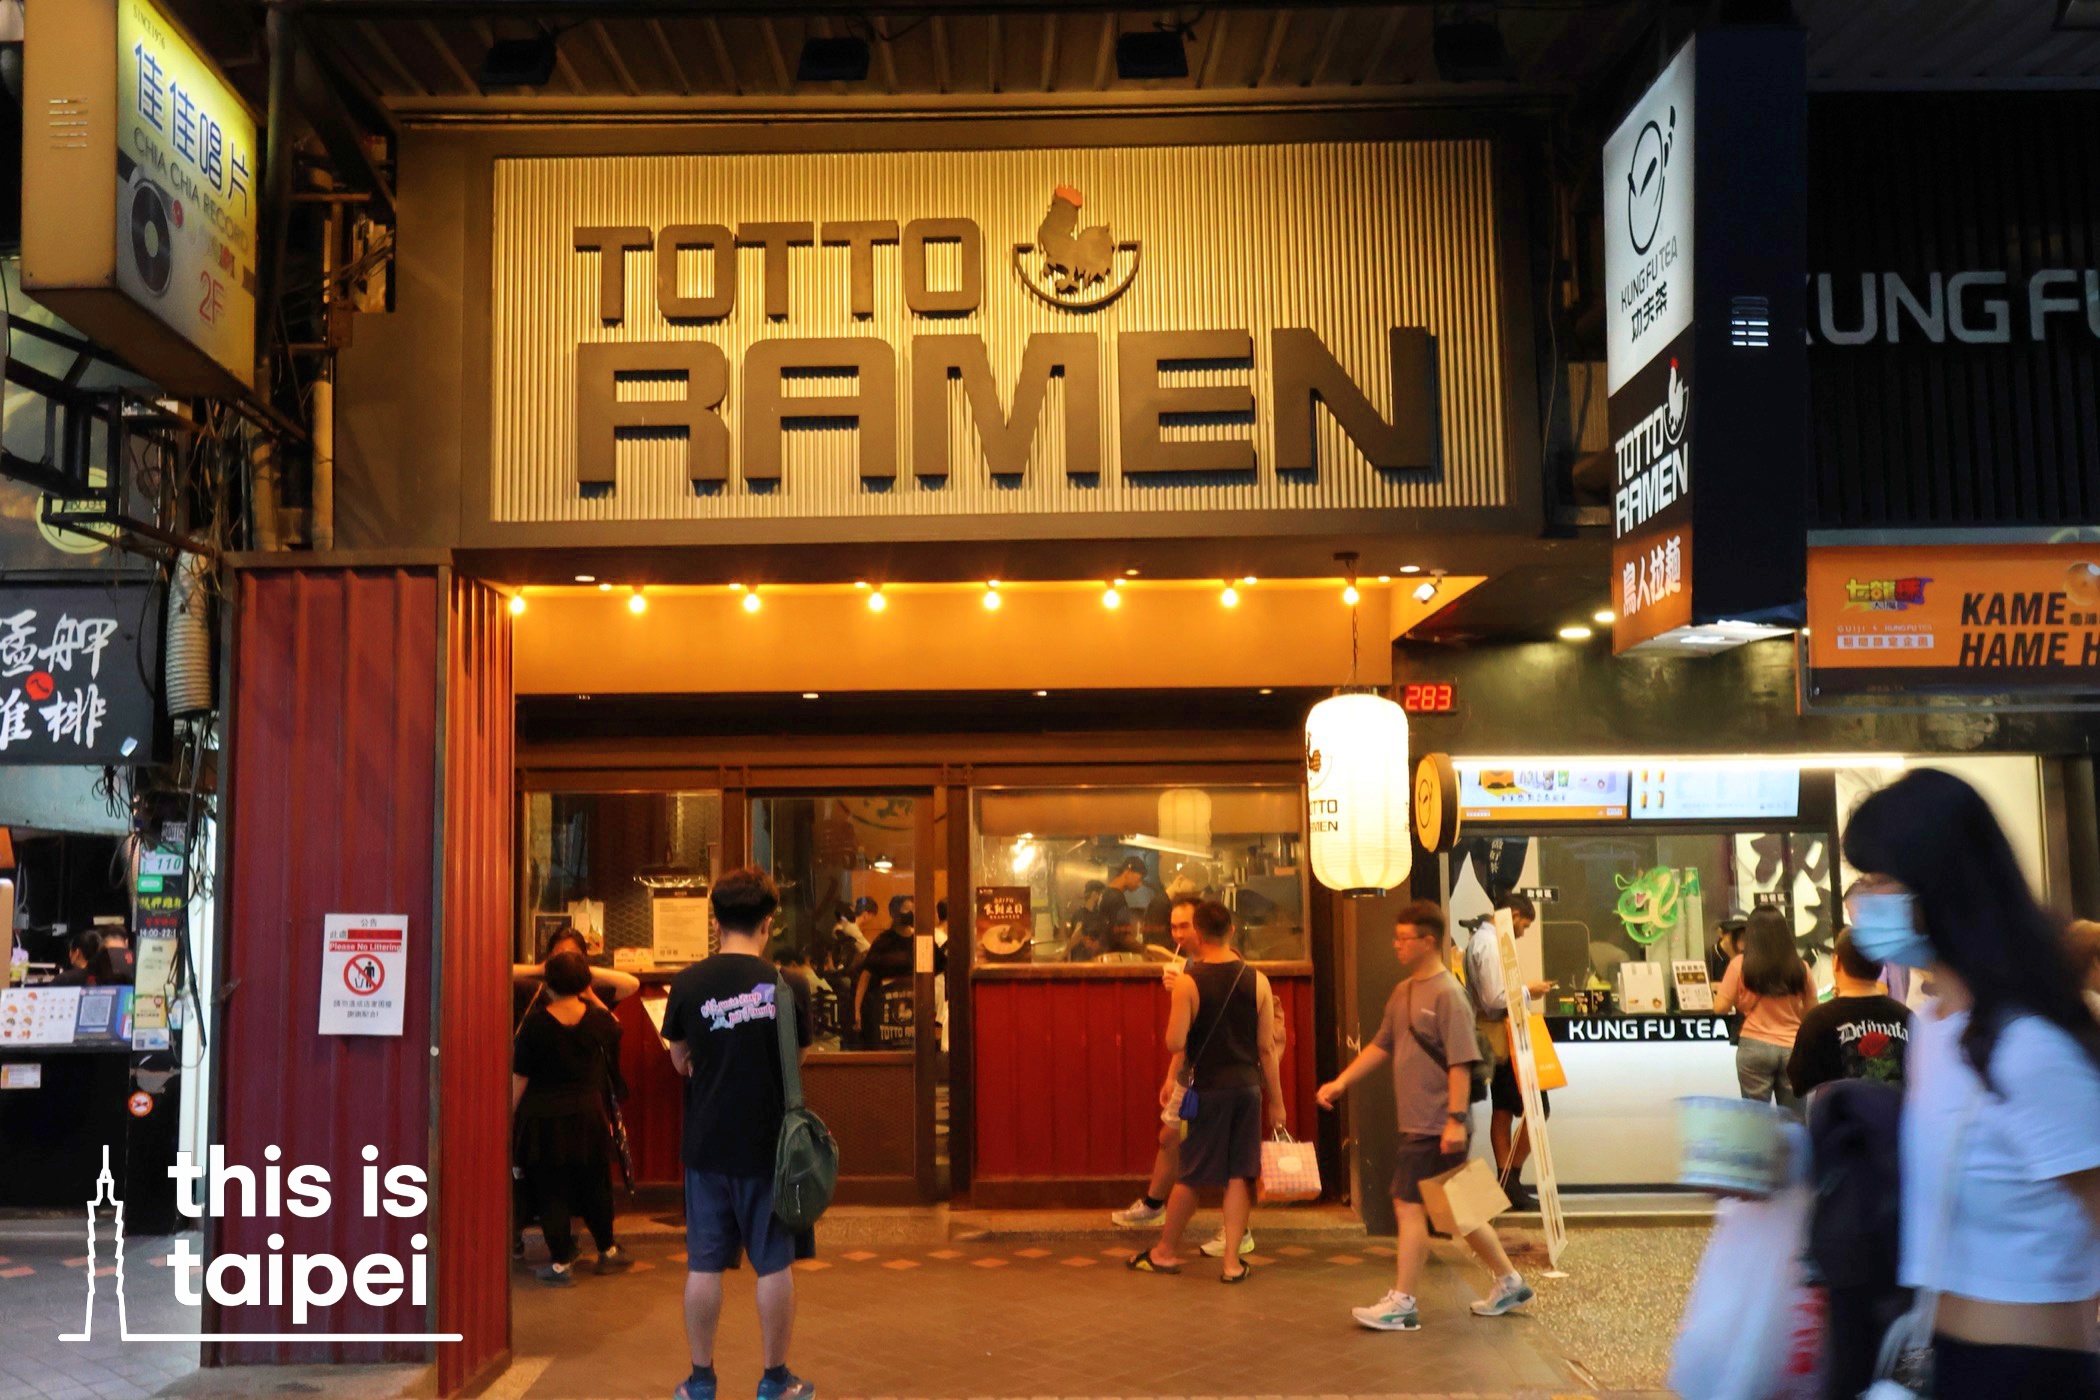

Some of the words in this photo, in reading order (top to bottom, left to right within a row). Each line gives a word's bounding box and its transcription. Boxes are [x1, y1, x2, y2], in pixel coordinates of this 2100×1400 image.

[134, 43, 249, 218] 佳佳唱片
[133, 126, 168, 176] CHIA
[169, 162, 200, 209] CHIA
[203, 192, 249, 256] RECORD
[199, 270, 225, 325] 2F
[573, 217, 982, 328] TOTTO
[1620, 268, 1645, 313] KUNG
[1645, 254, 1658, 289] FU
[1659, 235, 1679, 272] TEA
[1631, 280, 1668, 343] 功夫茶
[1806, 271, 2011, 345] UNG
[576, 325, 1444, 498] RAMEN
[1615, 404, 1665, 486] TOTTO
[1615, 441, 1689, 540] RAMEN
[1961, 591, 2067, 626] KAME
[1958, 631, 2069, 668] HAME
[1405, 685, 1453, 711] 283
[157, 857, 181, 871] 110
[329, 942, 355, 951] Please
[357, 942, 369, 951] No
[369, 942, 402, 953] Littering
[1568, 1018, 1638, 1040] KUNG
[1644, 1018, 1676, 1040] FU
[1681, 1018, 1730, 1039] TEA
